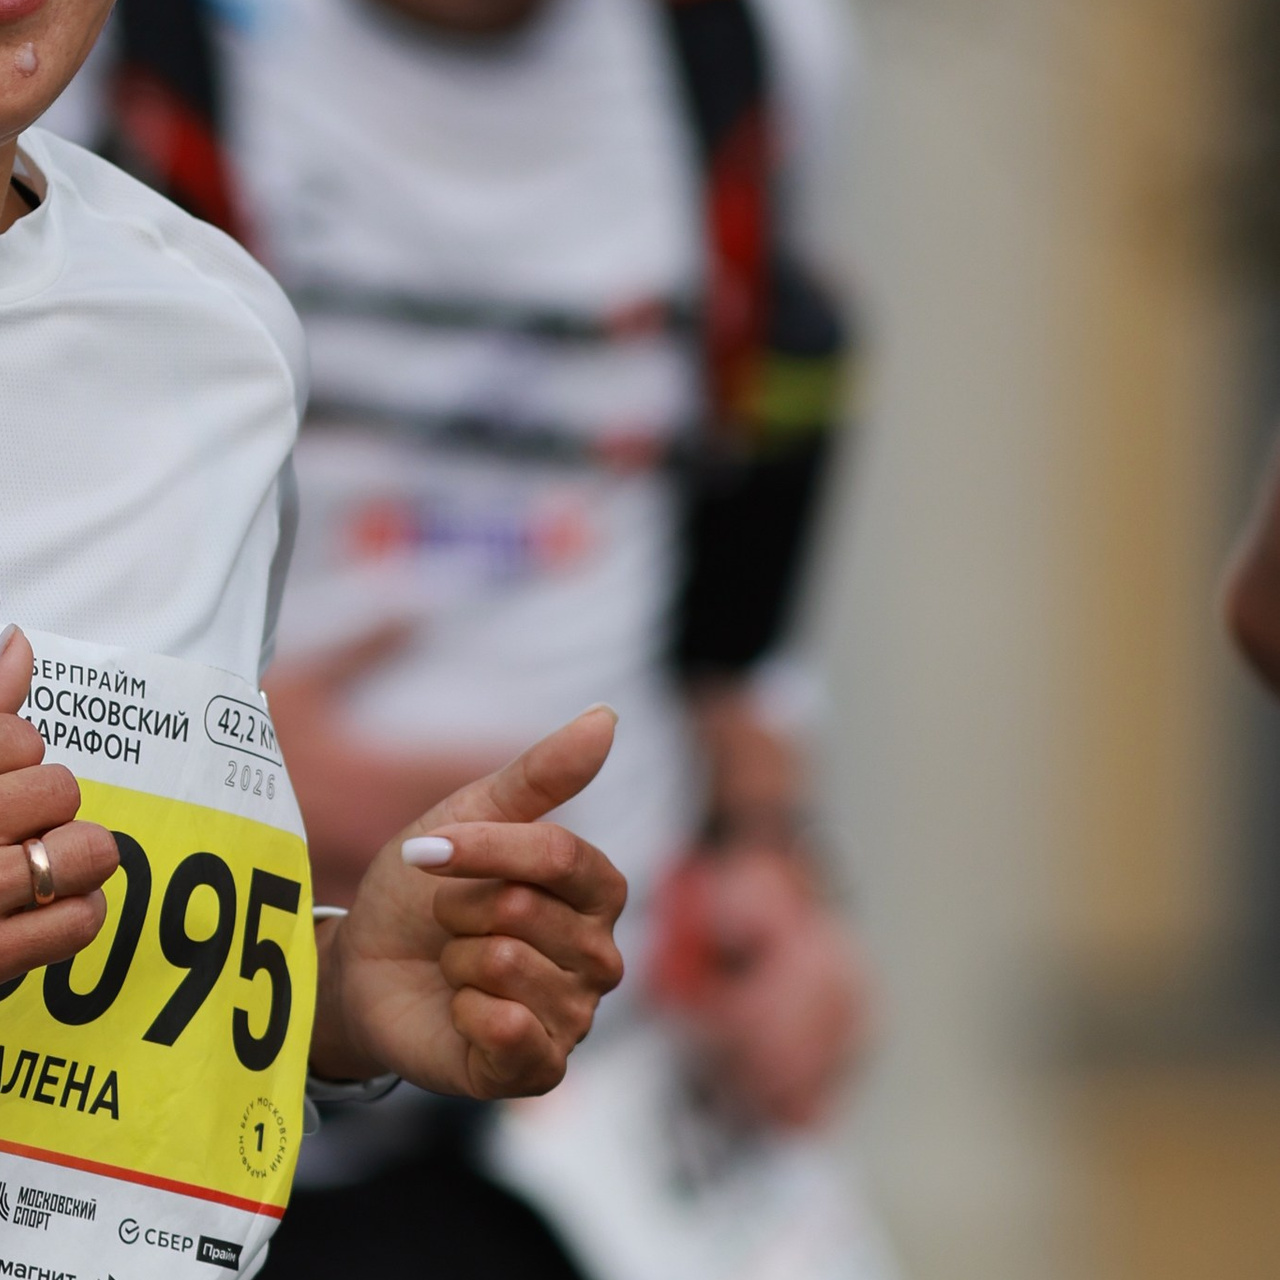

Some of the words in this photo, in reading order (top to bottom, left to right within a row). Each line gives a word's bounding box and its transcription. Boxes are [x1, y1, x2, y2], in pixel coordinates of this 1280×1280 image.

[31, 657, 146, 699] БЕРПРАЙМ
[24, 714, 141, 764] АРАФОН
[218, 707, 255, 743] 42,2
[224, 760, 276, 800] 2026
[253, 1122, 265, 1152] 1
[12, 1204, 52, 1231] СПОРТ
[17, 1186, 97, 1221] МОСКОВСКИЙ
[144, 1228, 194, 1253] СБЕР
[202, 1243, 237, 1263] Прайм
